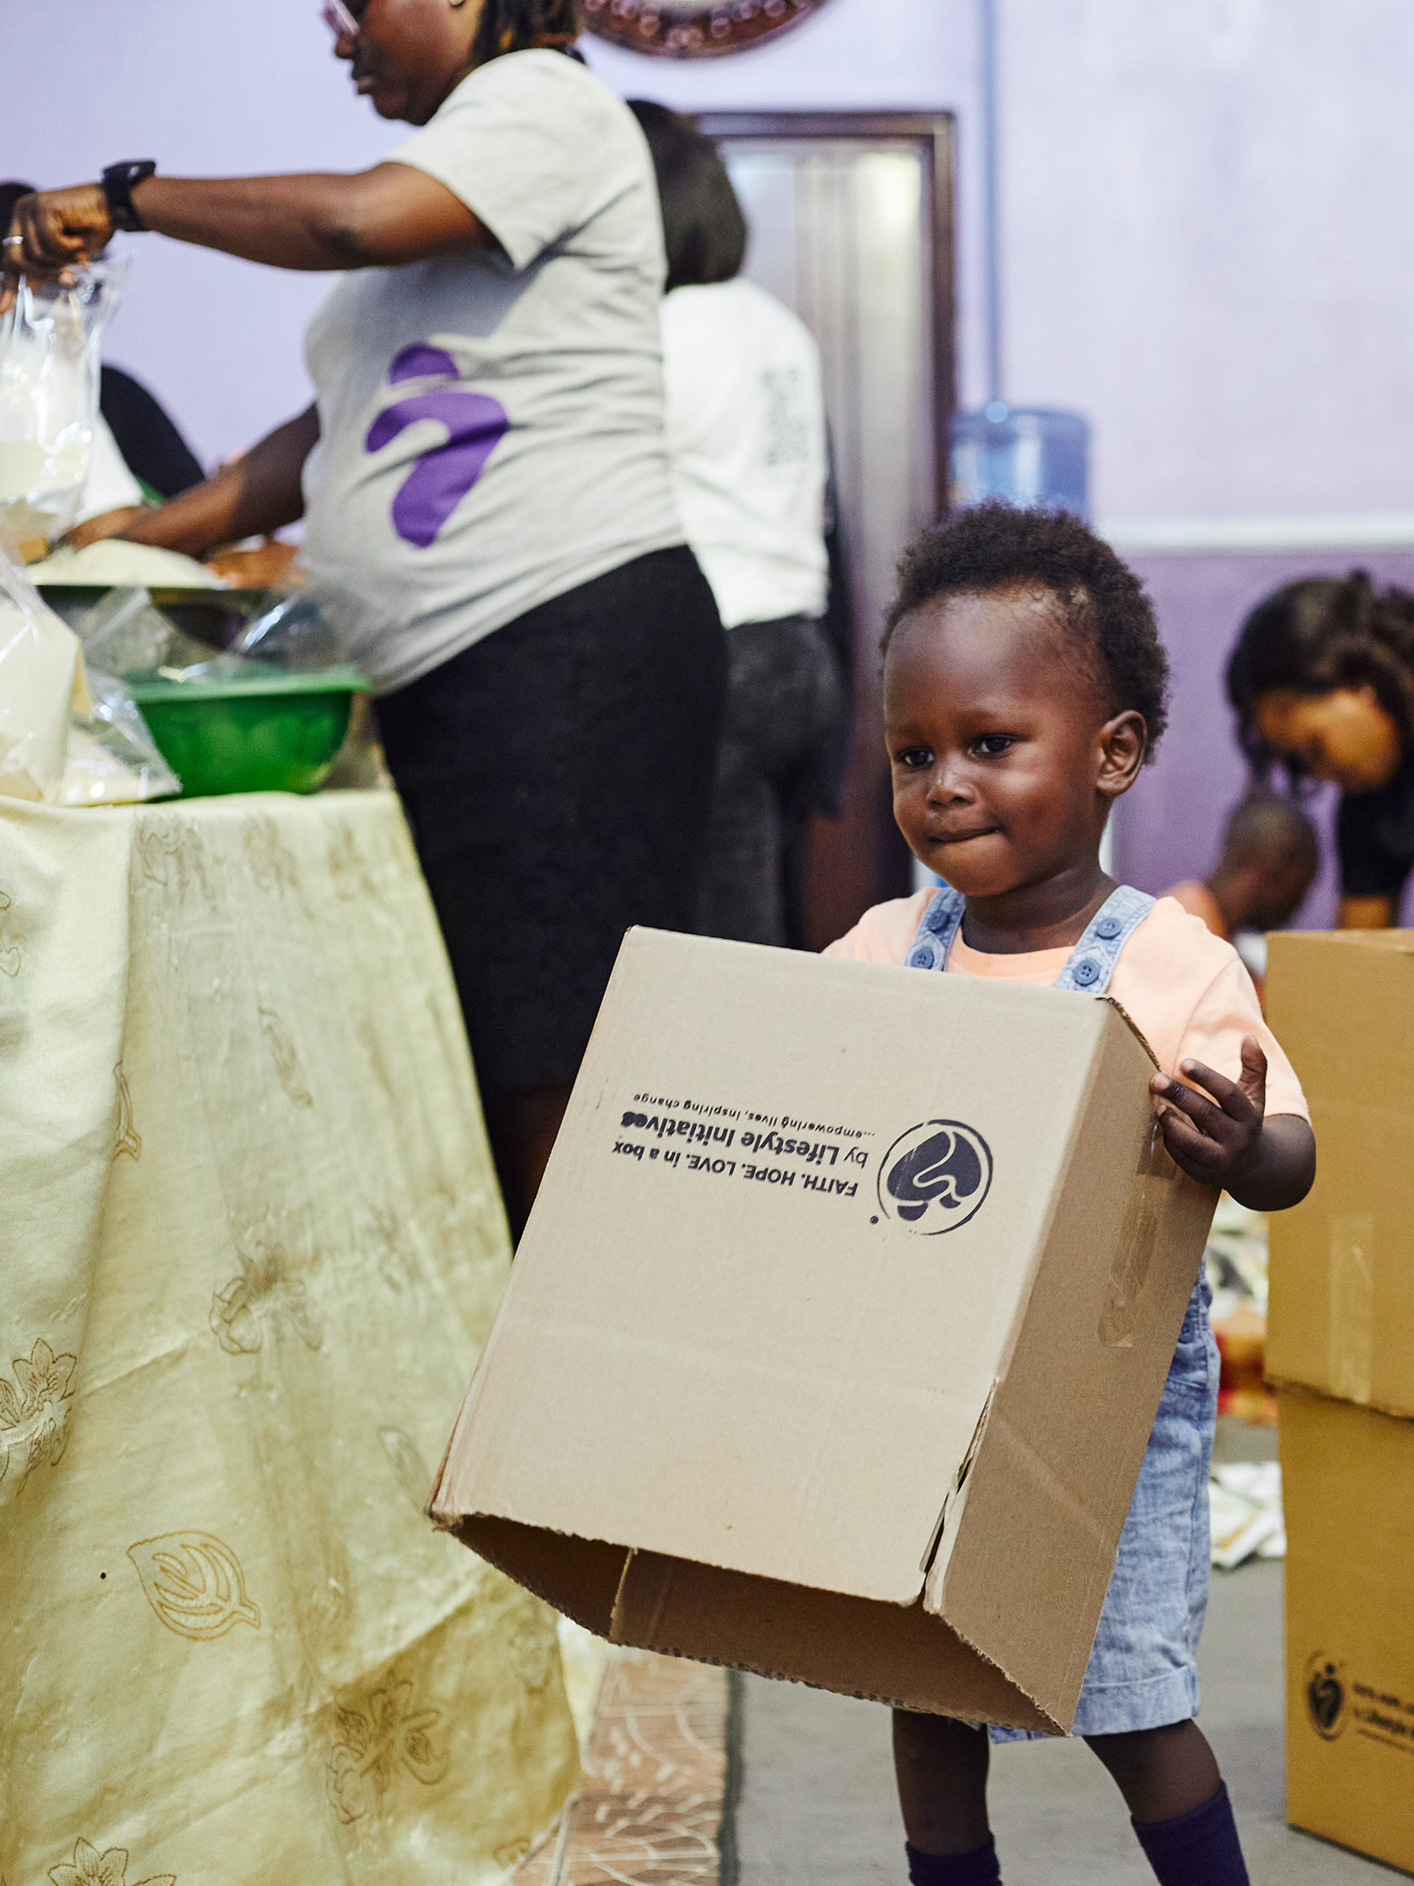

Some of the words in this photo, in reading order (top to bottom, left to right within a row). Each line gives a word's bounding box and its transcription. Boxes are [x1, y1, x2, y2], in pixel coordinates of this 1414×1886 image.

[682, 1099, 742, 1122] inspiring
[744, 1110, 779, 1128] lives,
[619, 1110, 737, 1149] Initiatives
[611, 1140, 646, 1162] box
[648, 1147, 661, 1160] a
[663, 1149, 682, 1169] in
[740, 1130, 841, 1166] Lifestyle
[842, 1146, 870, 1170] by
[685, 1153, 737, 1177] LOVE.
[740, 1163, 797, 1187] HOPE.
[800, 1173, 859, 1198] FAITH.
